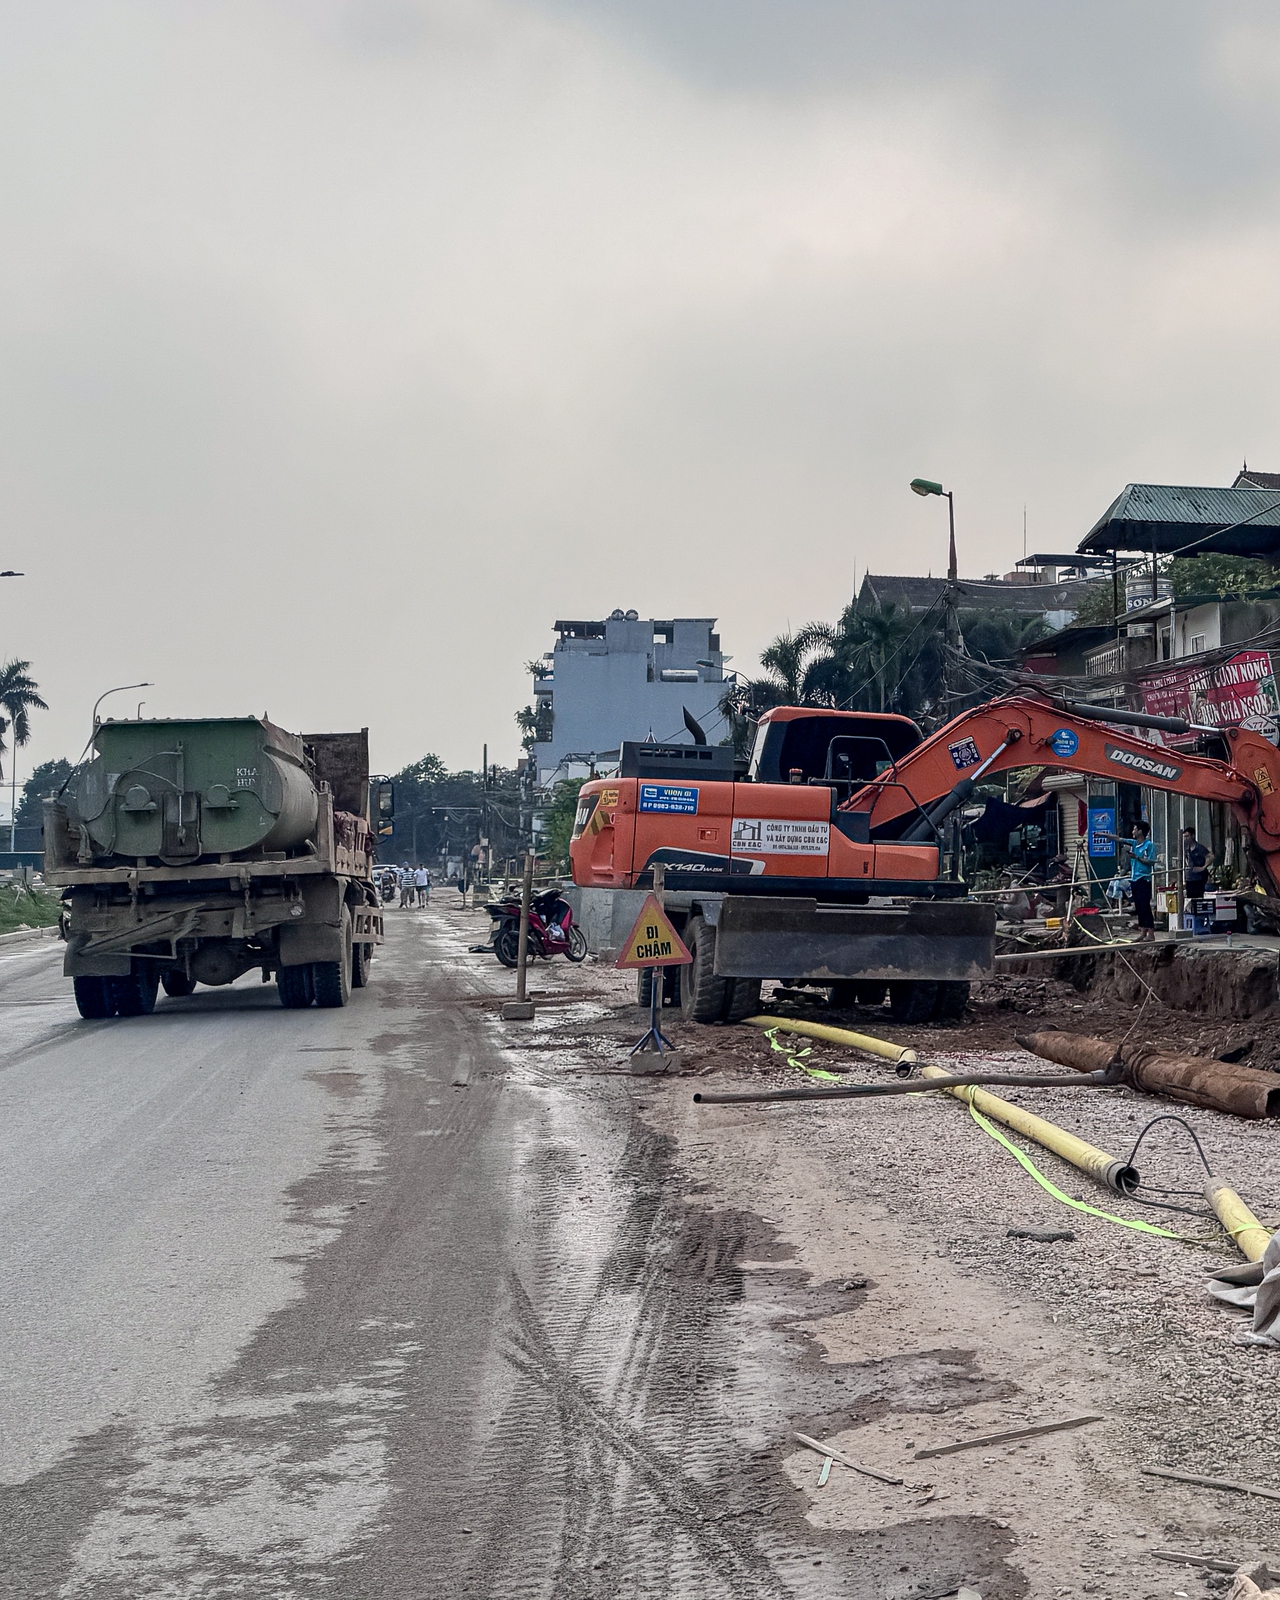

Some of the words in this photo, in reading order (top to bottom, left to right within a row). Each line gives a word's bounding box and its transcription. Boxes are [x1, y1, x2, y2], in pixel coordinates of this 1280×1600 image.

[1110, 749, 1177, 779] DOOSAN
[783, 825, 791, 833] TY
[646, 926, 659, 939] ĐI
[637, 940, 671, 959] CHẬM
